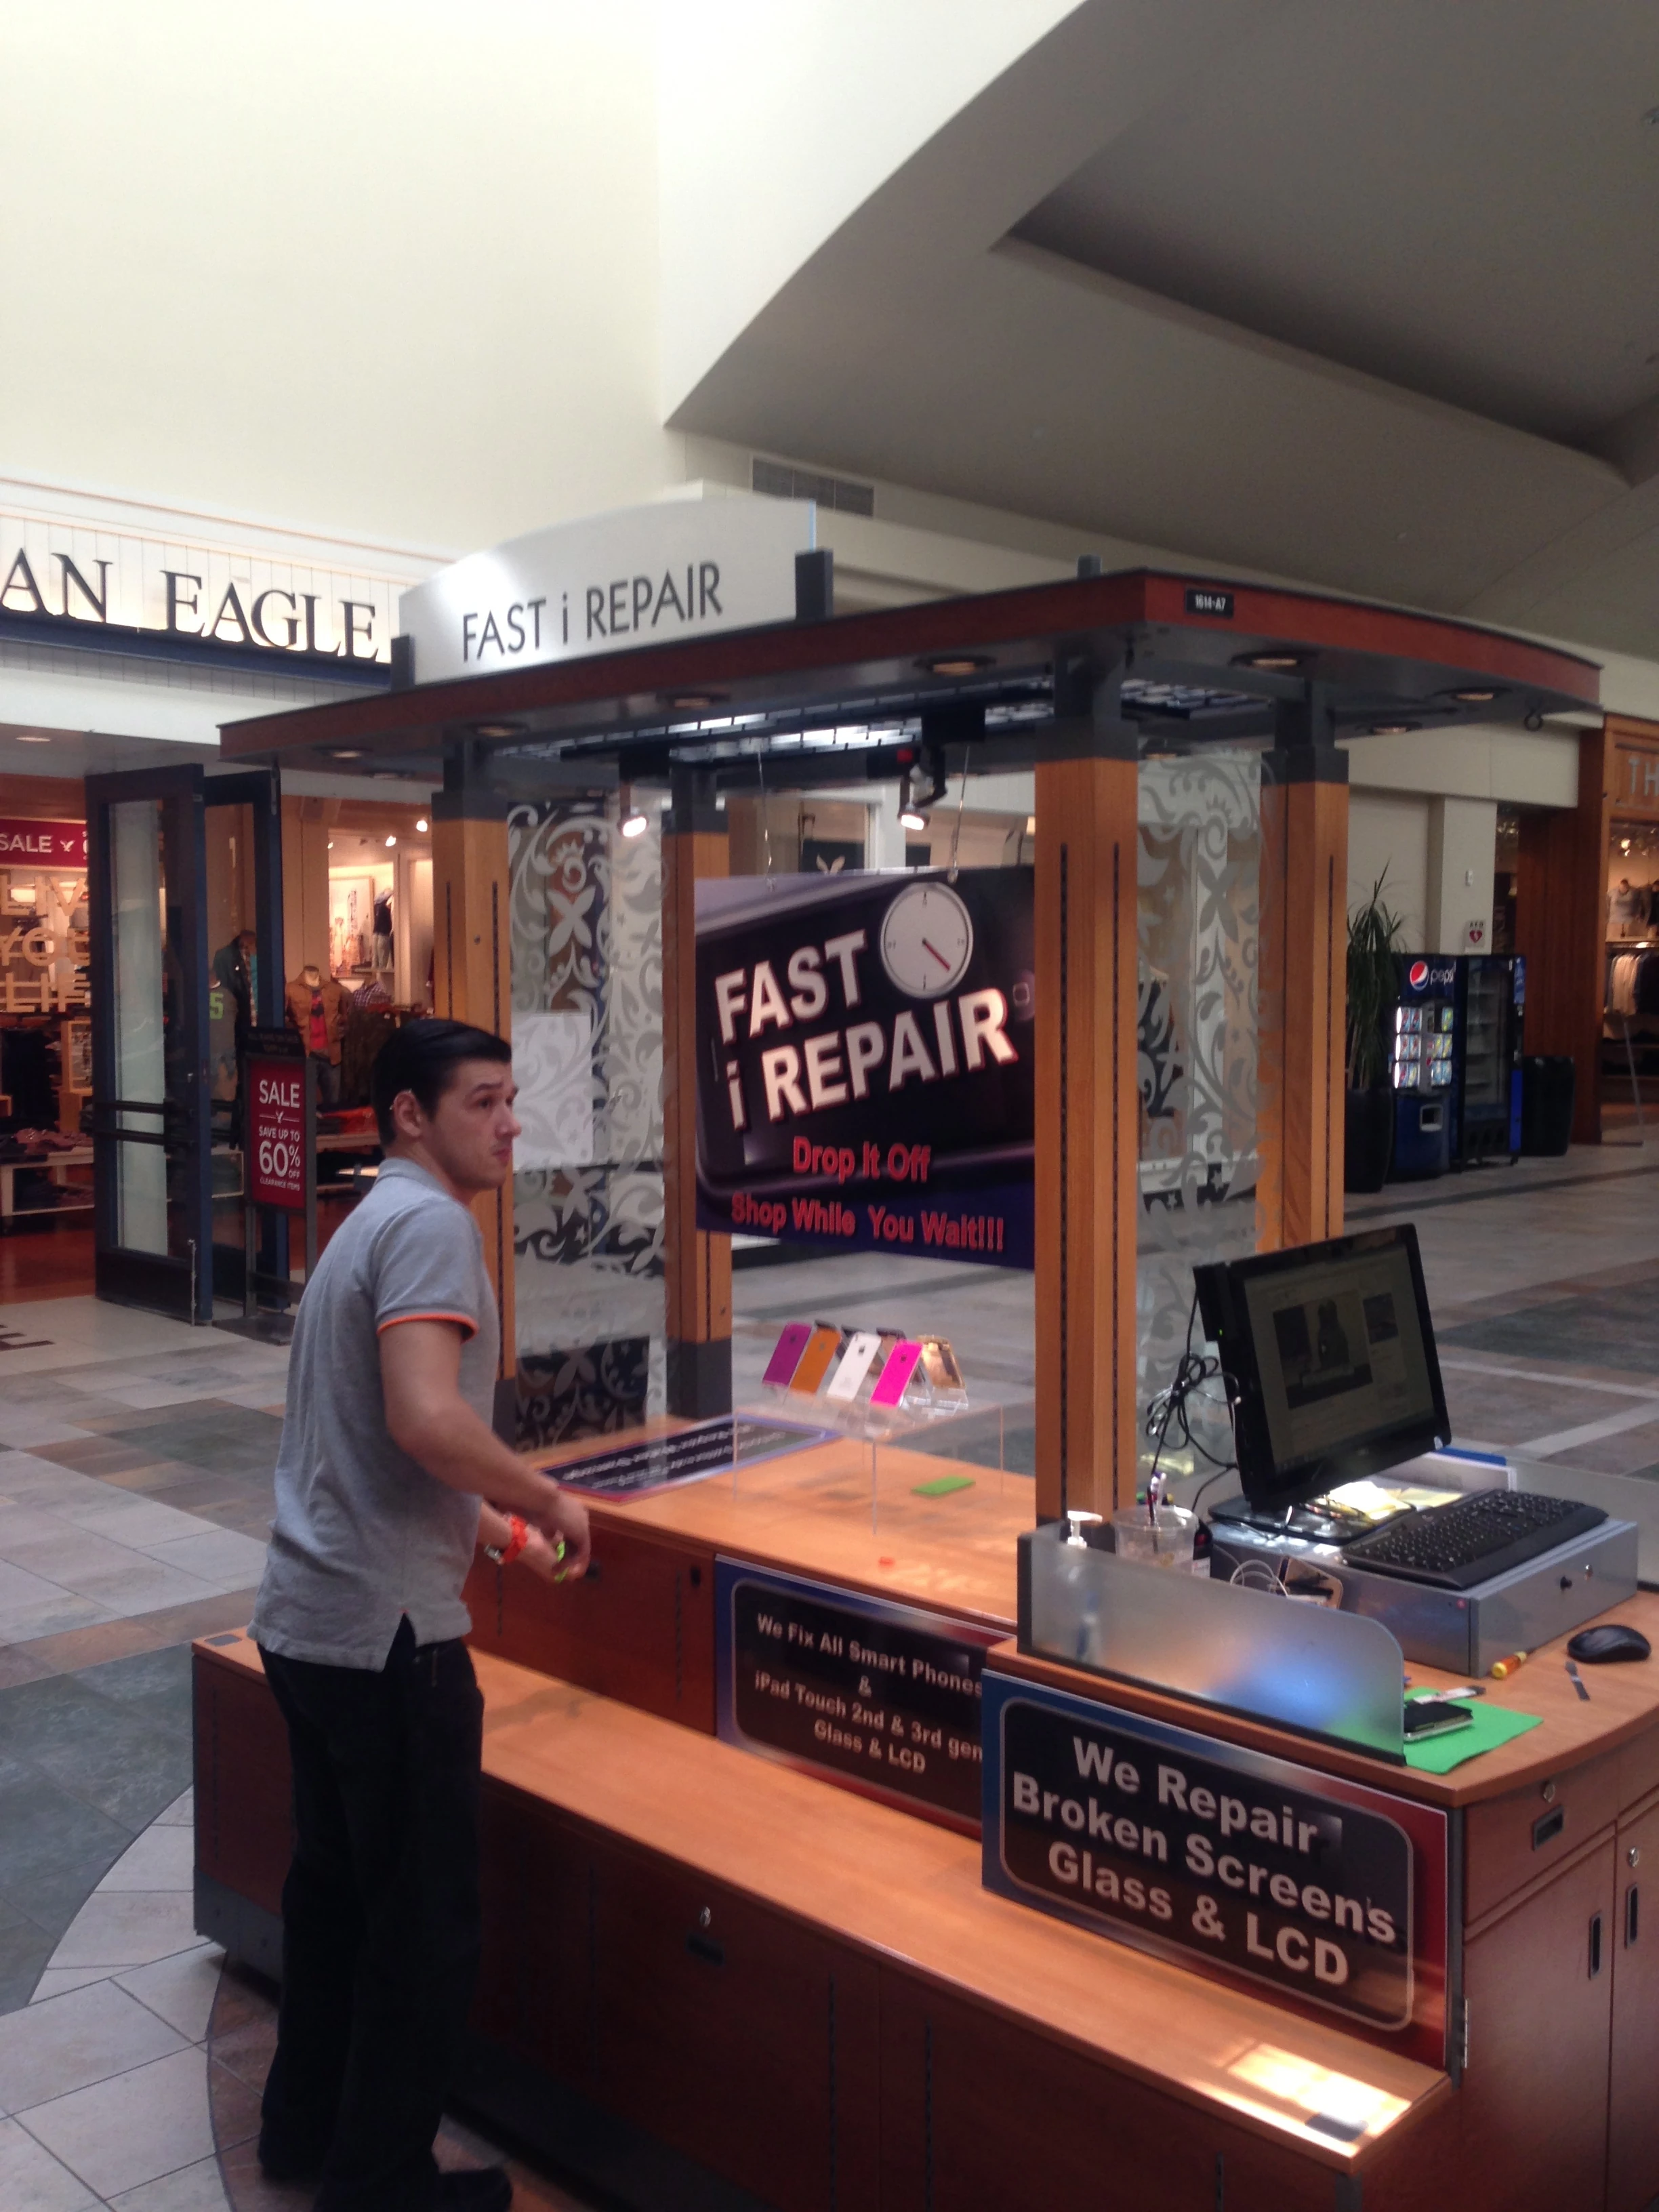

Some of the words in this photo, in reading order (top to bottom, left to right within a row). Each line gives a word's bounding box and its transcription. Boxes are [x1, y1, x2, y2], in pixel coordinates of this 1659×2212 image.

[0, 548, 112, 622] AN
[161, 570, 381, 659] EAGLE
[463, 596, 547, 662] FAST
[586, 560, 723, 641] REPAIR
[0, 834, 52, 853] SALE
[715, 929, 867, 1044] FAST
[761, 987, 1019, 1122] REPAIR
[259, 1078, 300, 1109] SALE
[258, 1125, 276, 1139] SAVE
[278, 1128, 289, 1140] UP
[290, 1130, 300, 1142] TO
[259, 1140, 300, 1177] 60%
[792, 1135, 855, 1185] Drop
[863, 1141, 880, 1179] It
[887, 1143, 931, 1183] Off
[288, 1170, 300, 1179] OFF
[731, 1191, 787, 1235] Shop
[792, 1197, 856, 1236] While
[867, 1204, 914, 1244] You
[921, 1210, 1004, 1252] Wait!!!
[757, 1612, 783, 1639] We
[788, 1622, 813, 1649] Fix
[819, 1632, 842, 1657] All
[849, 1640, 905, 1676] Smart
[912, 1658, 982, 1698] Phones
[858, 1675, 872, 1698] &
[755, 1670, 790, 1700] iPad
[795, 1683, 846, 1719] Touch
[851, 1702, 884, 1732] 2nd
[890, 1715, 905, 1738] &
[911, 1721, 941, 1750] 3rd
[948, 1737, 983, 1763] gen
[814, 1719, 863, 1754] Glass
[868, 1737, 882, 1761] &
[888, 1742, 926, 1774] LCD
[1071, 1736, 1140, 1795] We
[1158, 1763, 1318, 1853] Repair
[1013, 1772, 1168, 1863] Broken
[1185, 1832, 1396, 1944] Screens
[1048, 1841, 1174, 1921] Glass
[1191, 1895, 1226, 1942] &
[1246, 1913, 1349, 1986] LCD
